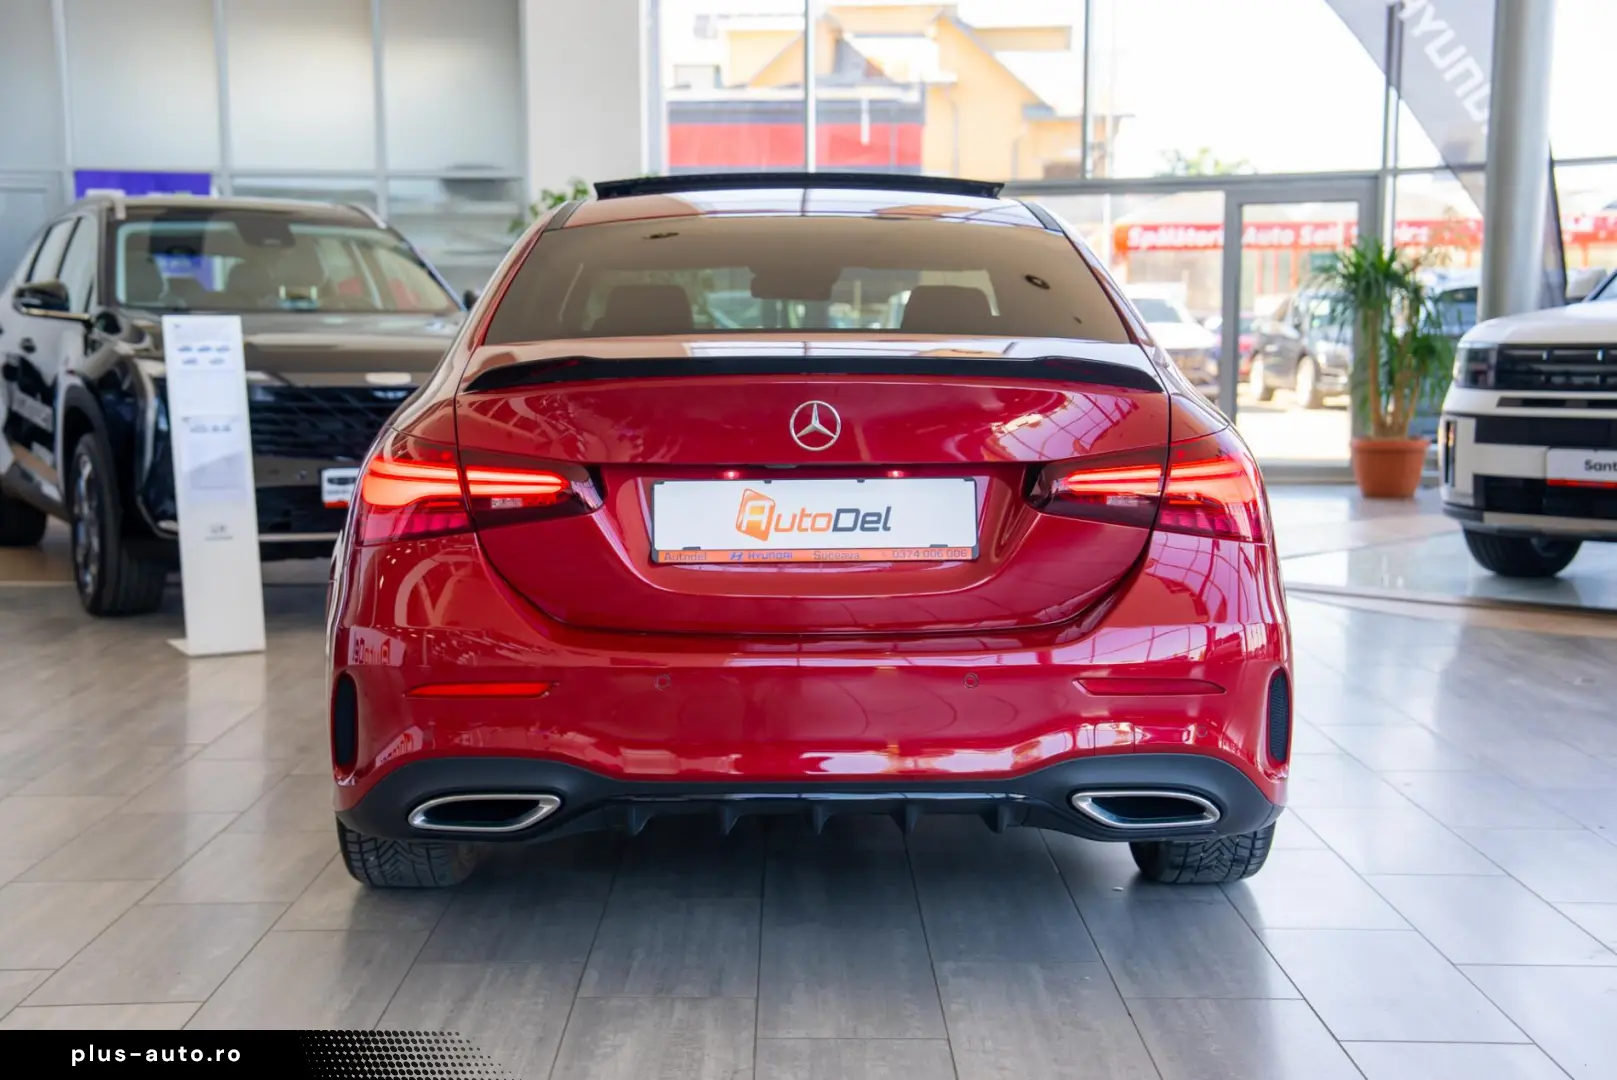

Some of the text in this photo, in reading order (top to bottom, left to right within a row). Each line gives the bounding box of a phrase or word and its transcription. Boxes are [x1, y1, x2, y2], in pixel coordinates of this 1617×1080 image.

[1398, 0, 1491, 136] YUND
[1241, 225, 1296, 247] Auto
[736, 489, 891, 541] AutoDel
[664, 551, 707, 562] Autodel
[747, 551, 793, 560] HYUNDAI
[813, 551, 860, 561] Suceava
[892, 549, 920, 559] 0374
